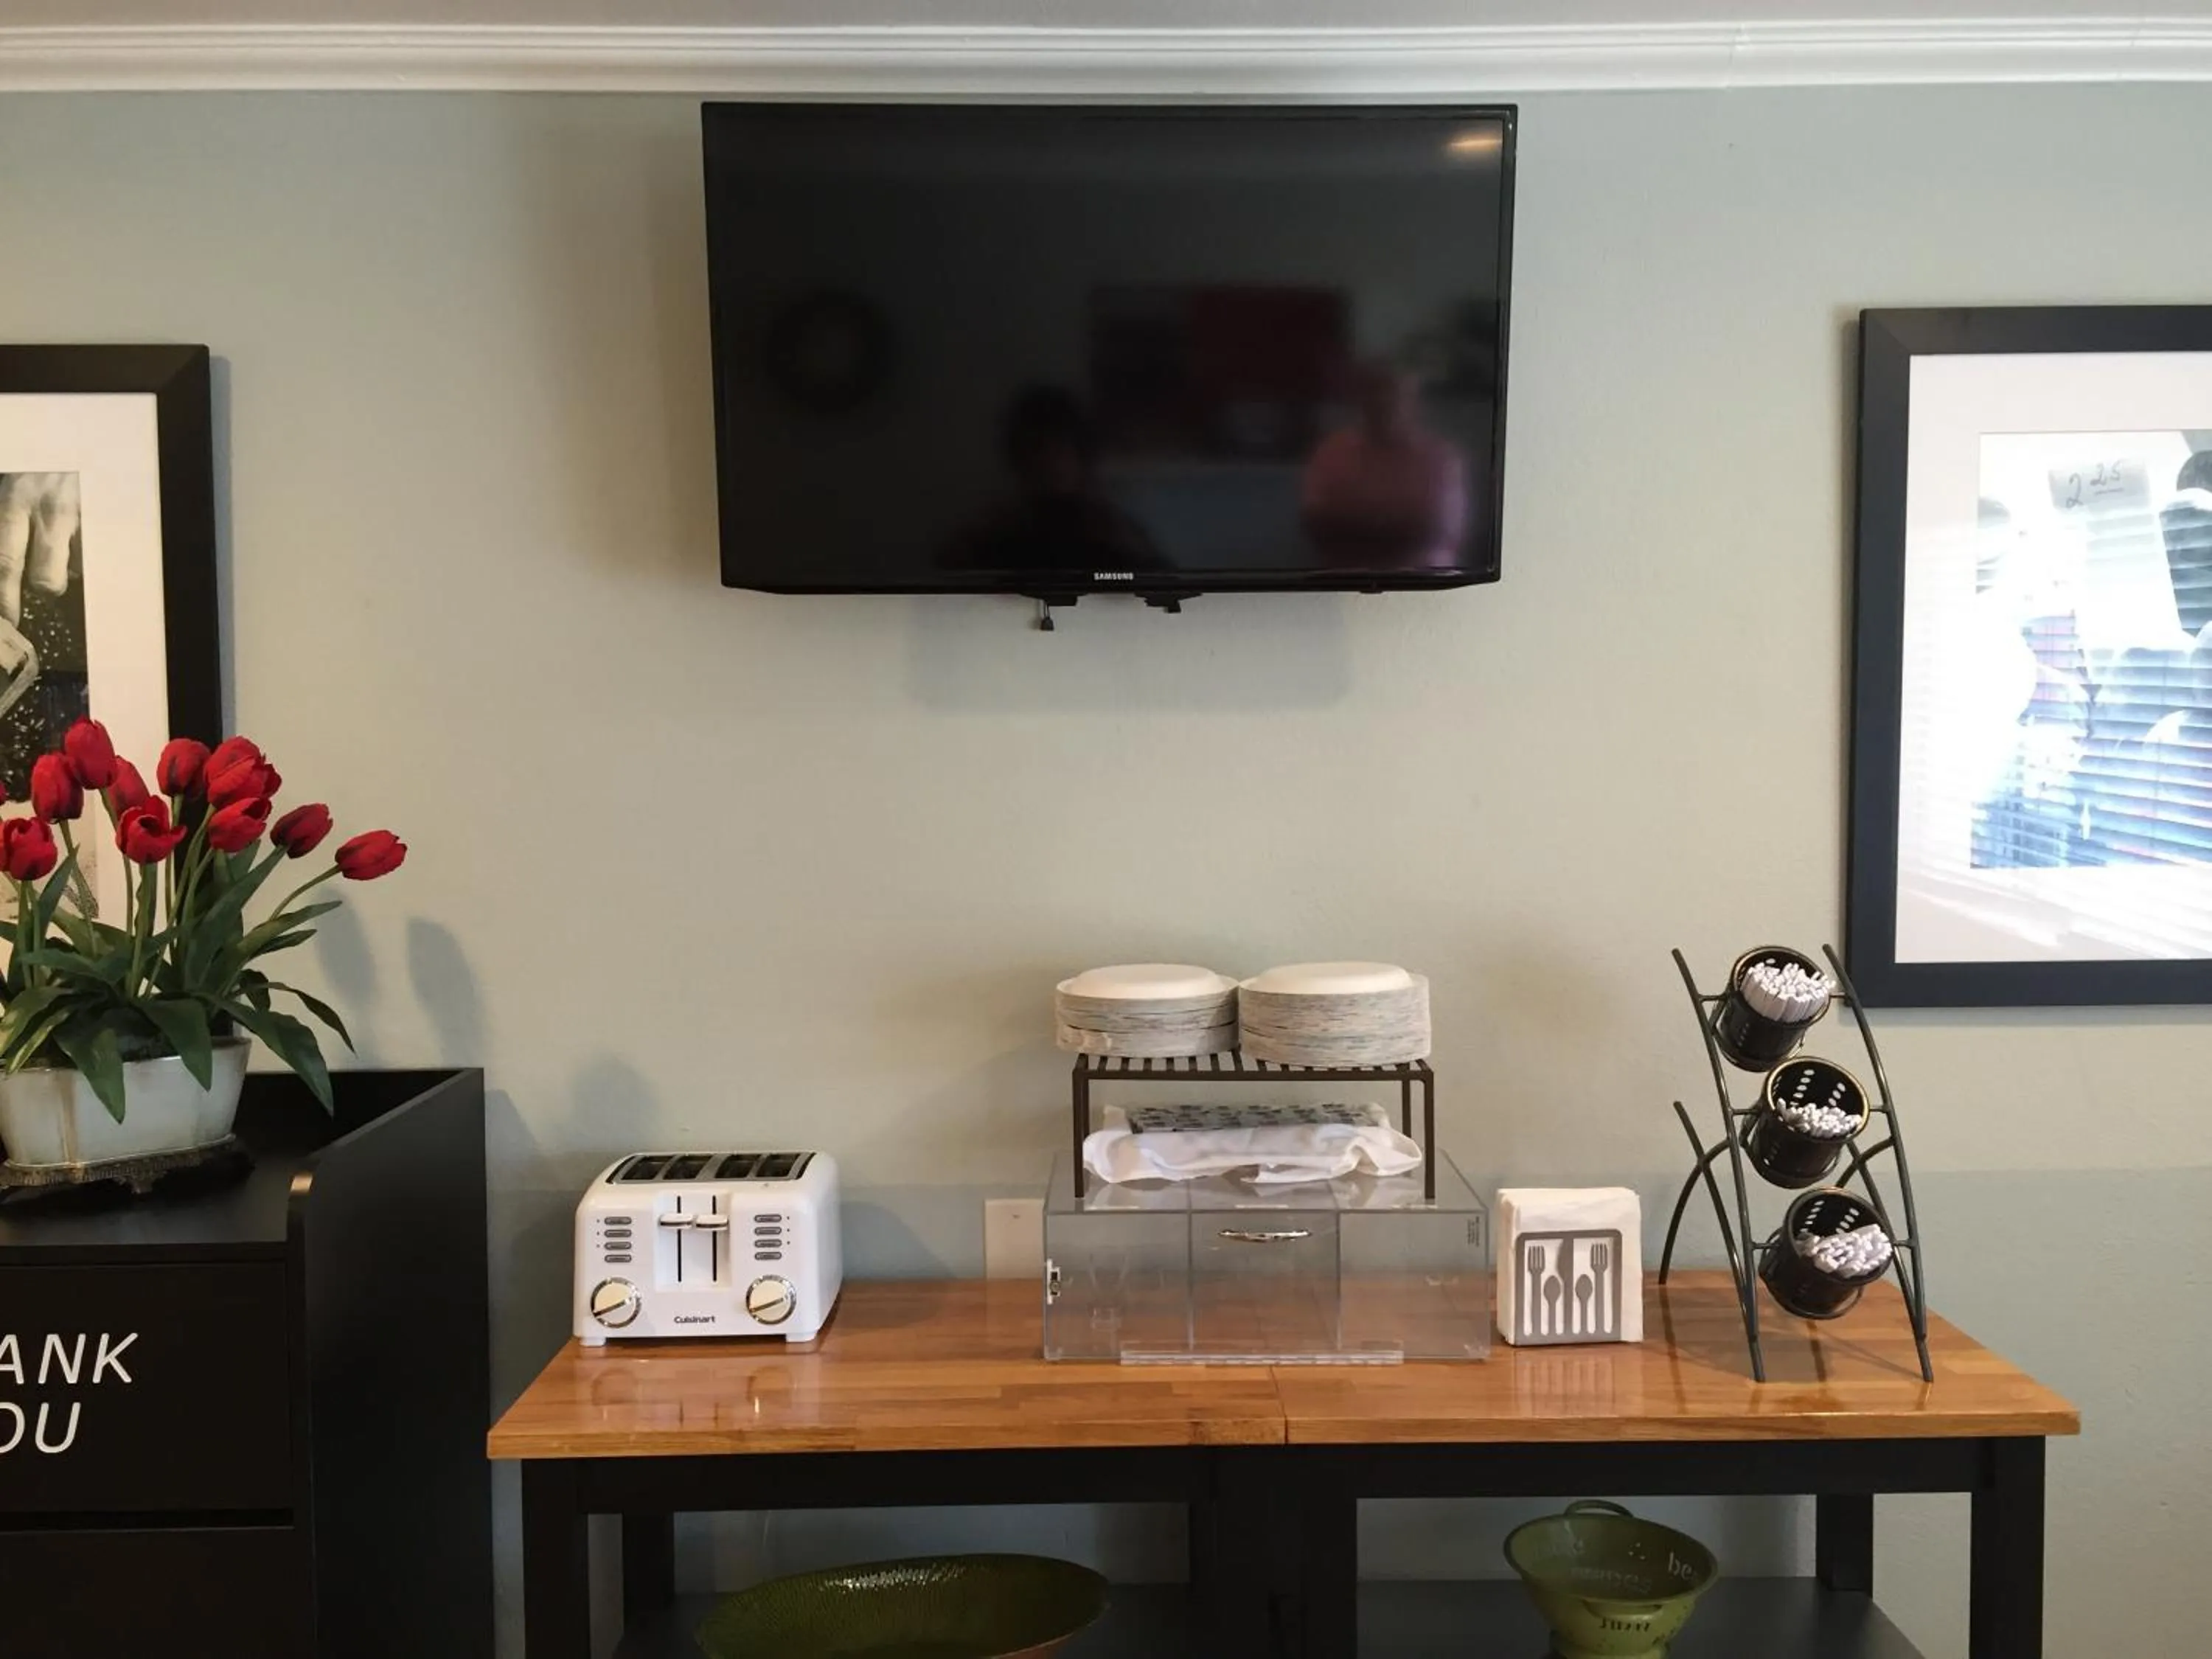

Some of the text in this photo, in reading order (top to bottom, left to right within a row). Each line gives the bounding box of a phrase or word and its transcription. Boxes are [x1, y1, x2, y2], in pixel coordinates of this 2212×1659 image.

[1093, 571, 1134, 581] SAMSUNG
[674, 1315, 715, 1324] Cuisinart
[0, 1332, 139, 1384] ANK
